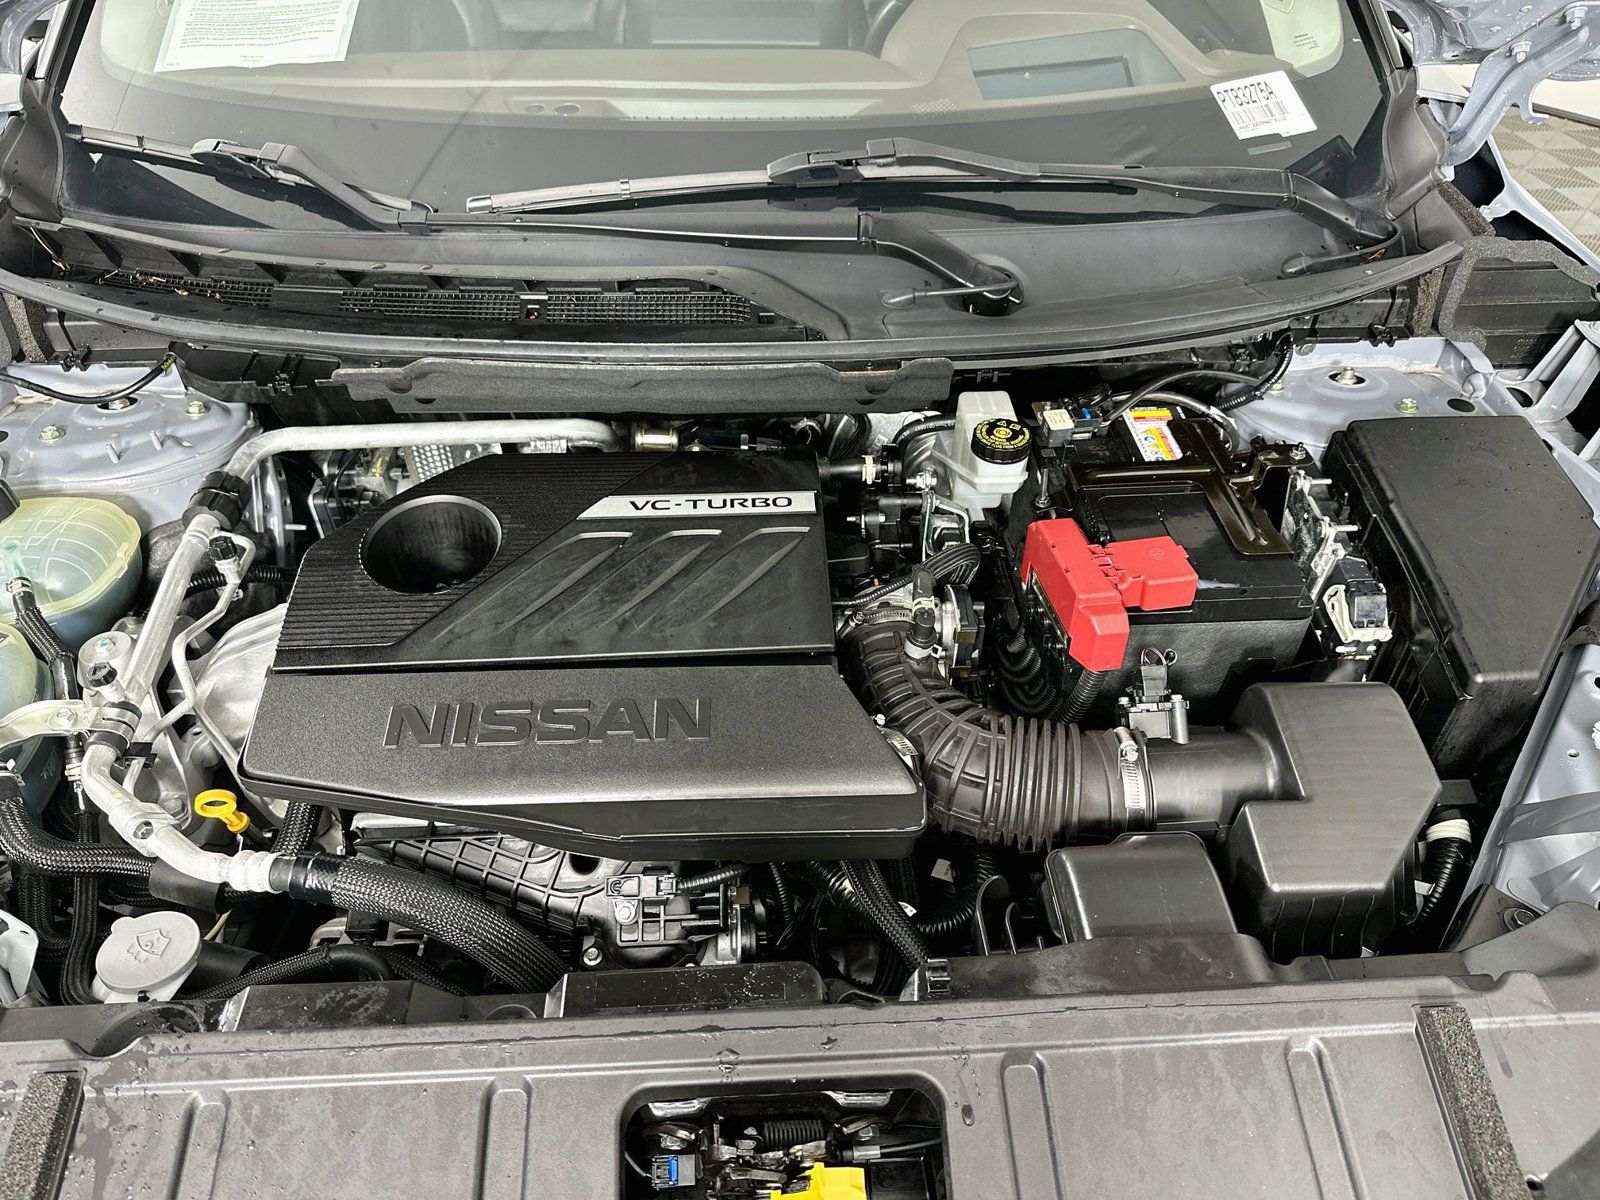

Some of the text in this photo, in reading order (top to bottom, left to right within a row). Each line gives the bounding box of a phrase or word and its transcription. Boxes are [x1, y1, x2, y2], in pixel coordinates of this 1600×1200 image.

[1216, 81, 1277, 110] PTB3275A
[629, 496, 793, 511] VC-TURBO
[382, 699, 712, 748] NISSAN
